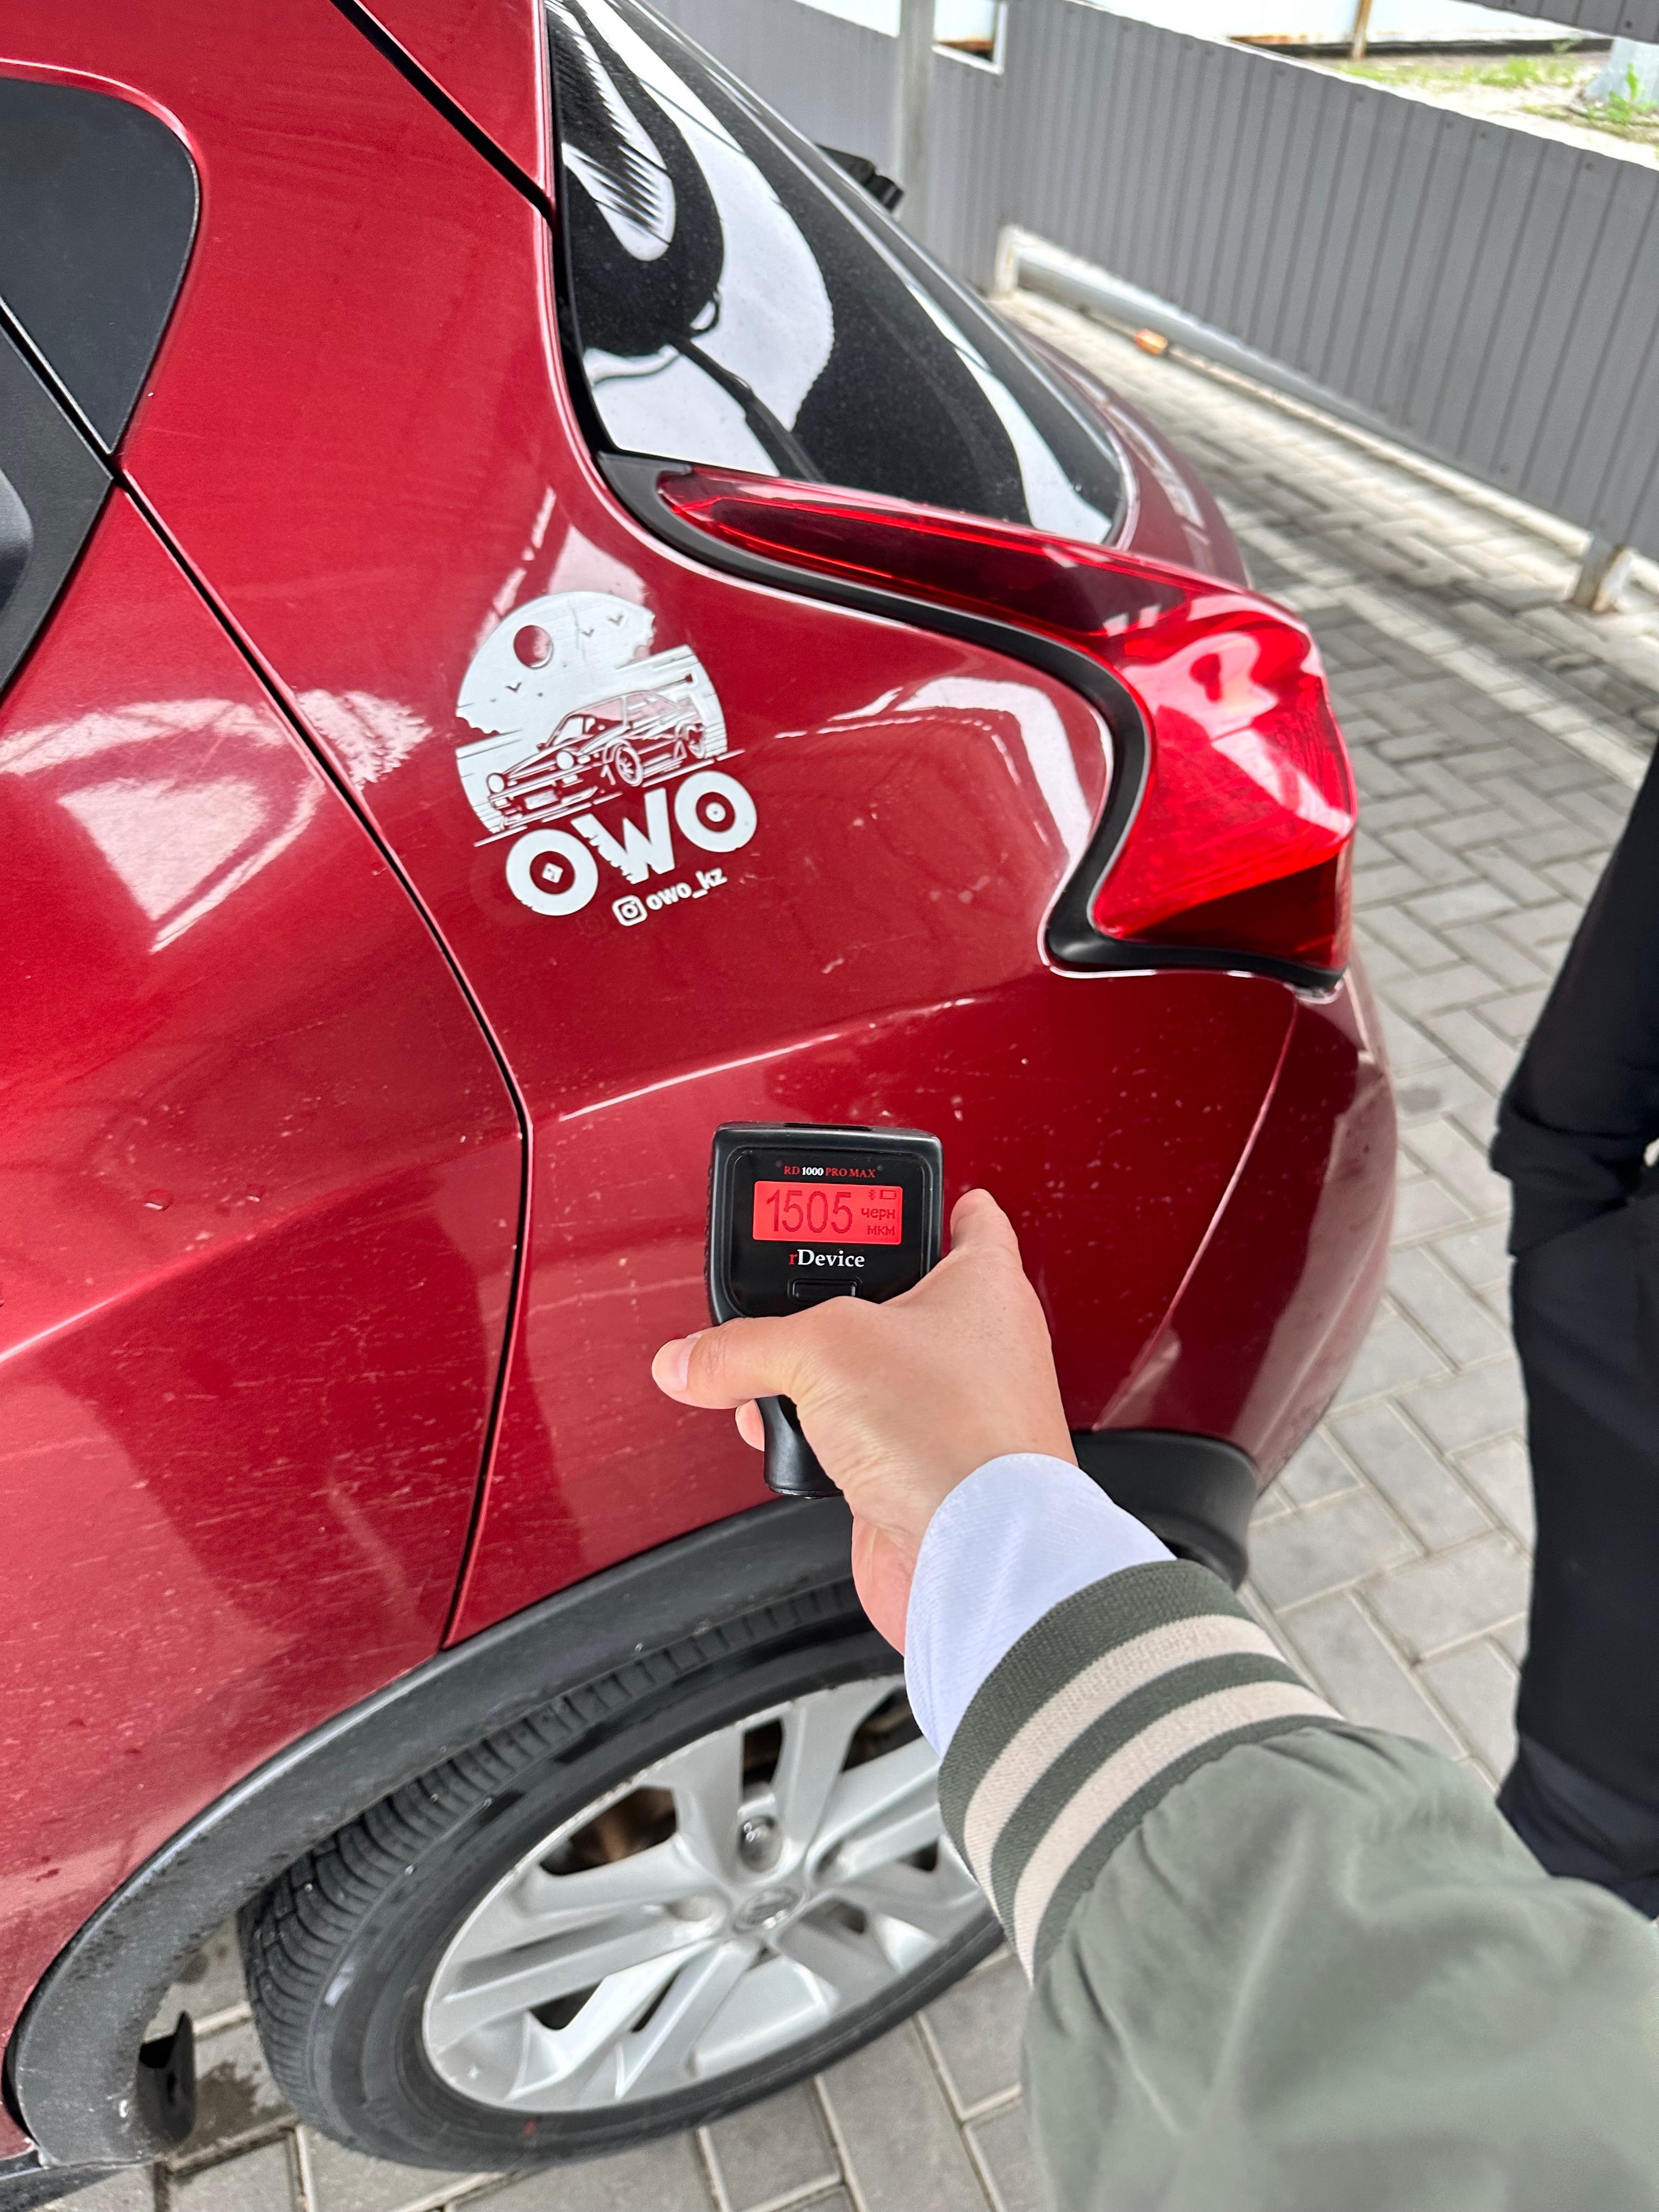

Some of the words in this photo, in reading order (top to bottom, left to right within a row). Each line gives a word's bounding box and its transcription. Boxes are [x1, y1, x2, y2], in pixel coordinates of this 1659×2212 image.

[505, 770, 758, 916] OWO
[646, 867, 727, 911] owo_kz
[784, 1166, 800, 1175] RD
[802, 1167, 823, 1176] 1000
[825, 1168, 847, 1177] PRO
[849, 1169, 876, 1178] MAX
[766, 1189, 853, 1233] 1505
[861, 1208, 895, 1220] черн
[789, 1249, 865, 1268] rDevice
